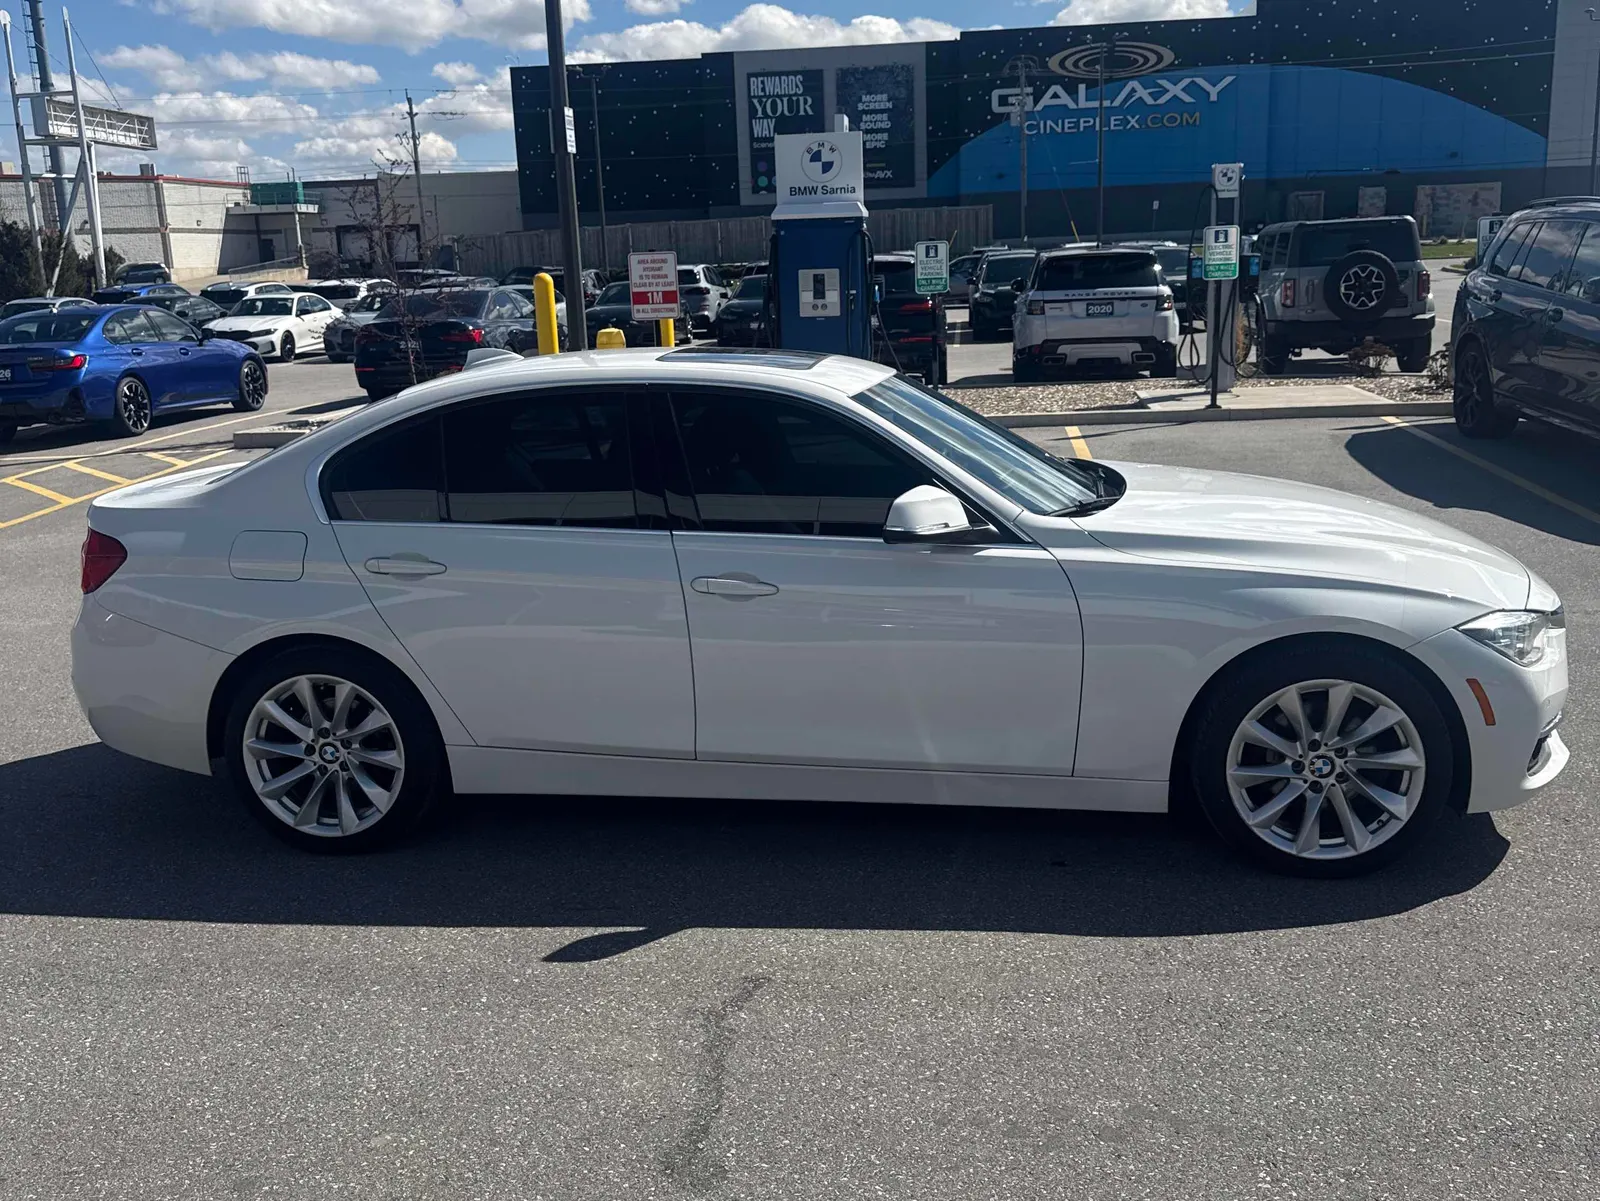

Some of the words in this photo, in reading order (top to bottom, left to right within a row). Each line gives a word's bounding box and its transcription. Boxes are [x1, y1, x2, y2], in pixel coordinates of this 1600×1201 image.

[750, 75, 803, 96] REWARDS
[862, 94, 888, 102] MORE
[991, 75, 1237, 113] GALAXY
[752, 96, 814, 117] YOUR
[857, 101, 893, 110] SCREEN
[862, 113, 888, 121] MORE
[1024, 111, 1200, 135] CINEPLEX.COM
[752, 118, 776, 138] WAY
[860, 121, 891, 130] SOUND
[863, 133, 889, 141] MORE
[806, 142, 837, 155] BMW
[866, 141, 886, 149] EPIC
[789, 185, 818, 197] BMW
[821, 184, 856, 196] Sarnia
[647, 291, 663, 304] 1M
[1088, 304, 1113, 314] 2020
